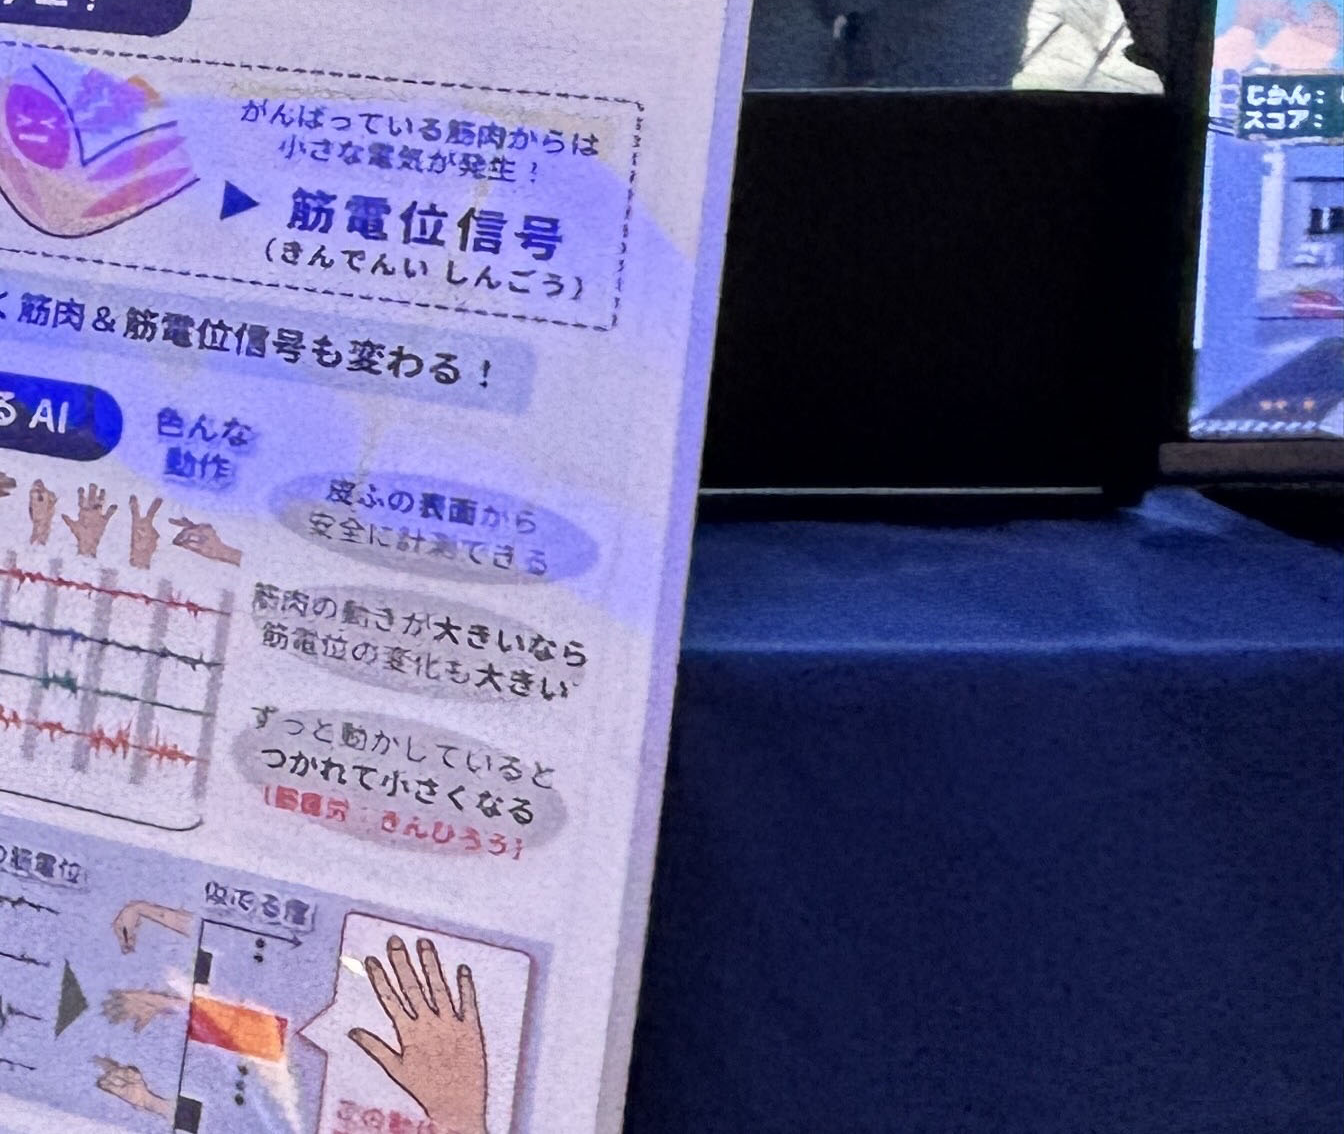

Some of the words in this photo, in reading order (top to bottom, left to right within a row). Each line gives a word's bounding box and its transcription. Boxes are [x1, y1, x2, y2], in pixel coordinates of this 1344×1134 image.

[287, 186, 563, 261] 筋電位信号
